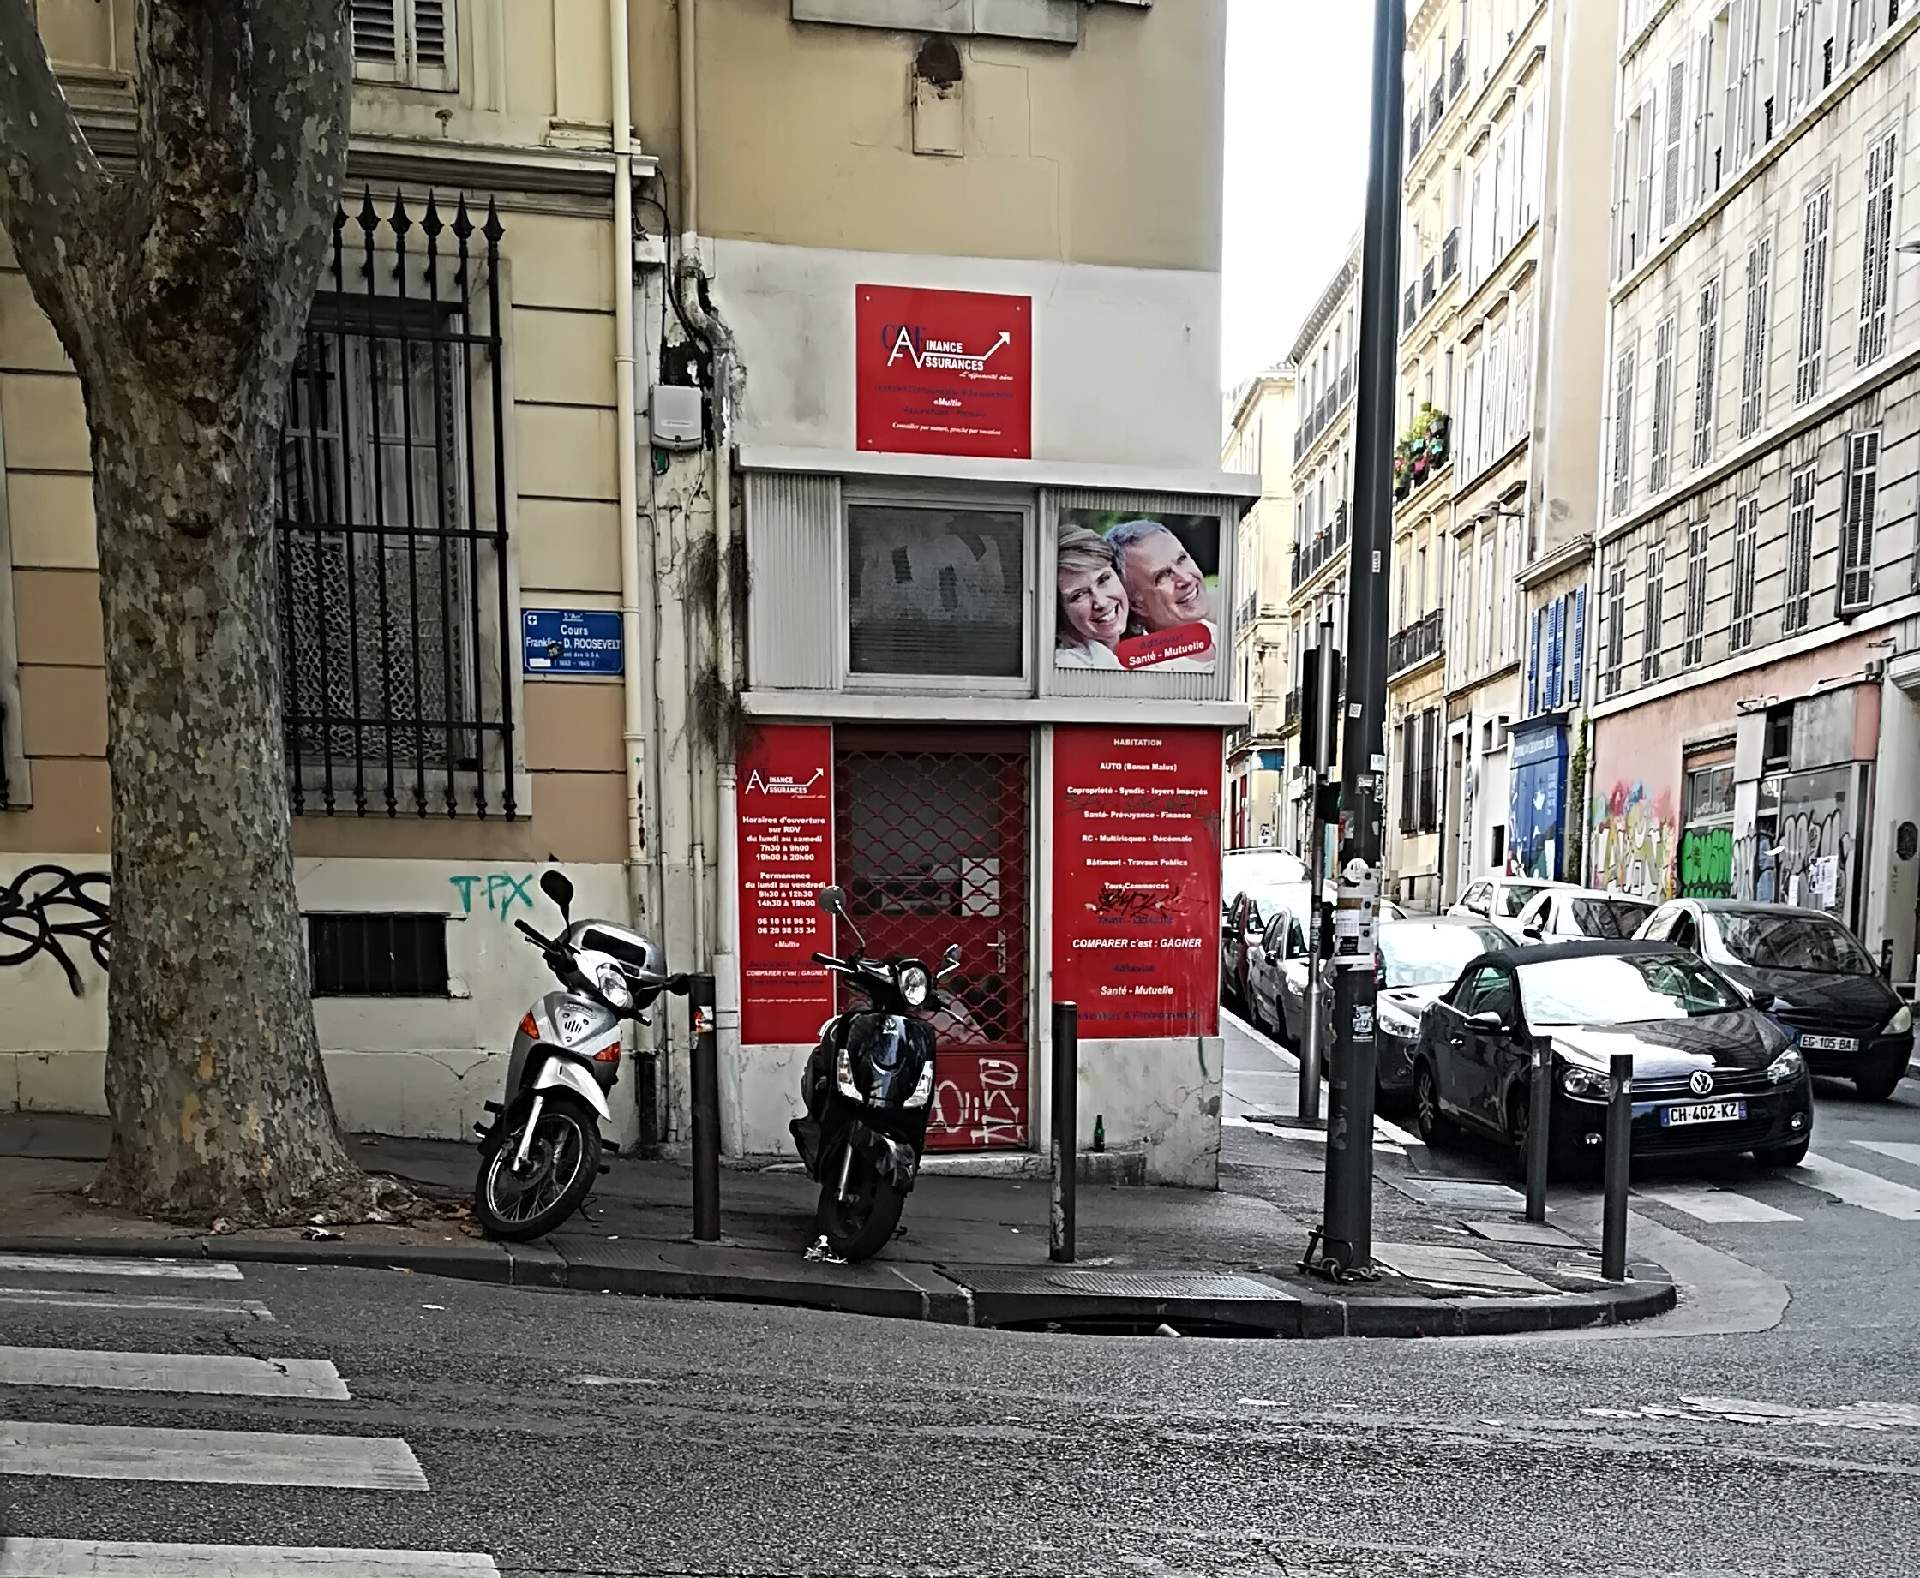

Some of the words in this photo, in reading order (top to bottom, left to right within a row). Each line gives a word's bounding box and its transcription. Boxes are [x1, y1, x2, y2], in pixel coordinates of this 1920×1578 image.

[560, 624, 589, 636] Cours
[574, 638, 621, 650] ROOSEVELT
[1129, 650, 1156, 666] Santé
[1164, 640, 1204, 657] Mutuelle
[1113, 738, 1162, 746] HABITATION
[1100, 762, 1122, 770] AUTO
[1123, 763, 1150, 772] (Bonus
[1151, 763, 1177, 772] Malus)
[1067, 786, 1114, 795] Copropriété
[1119, 786, 1145, 796] Syndic
[742, 815, 778, 824] Horaires
[779, 816, 826, 824] d'ouverture
[1110, 811, 1156, 820] Prévoyance
[1160, 811, 1192, 819] Finance
[758, 834, 779, 842] lundi
[1099, 834, 1147, 844] Multirisques
[1152, 835, 1193, 843] Décennale
[1086, 858, 1121, 866] Bâtiment
[760, 871, 811, 880] Permanence
[745, 881, 756, 889] du
[757, 881, 778, 889] lundi
[791, 881, 826, 889] vendredi
[1072, 939, 1128, 948] COMPARER
[1130, 939, 1152, 948] c'est
[1160, 938, 1202, 948] GAGNER
[1100, 985, 1127, 996] Santé
[1134, 985, 1174, 996] Mutuelle
